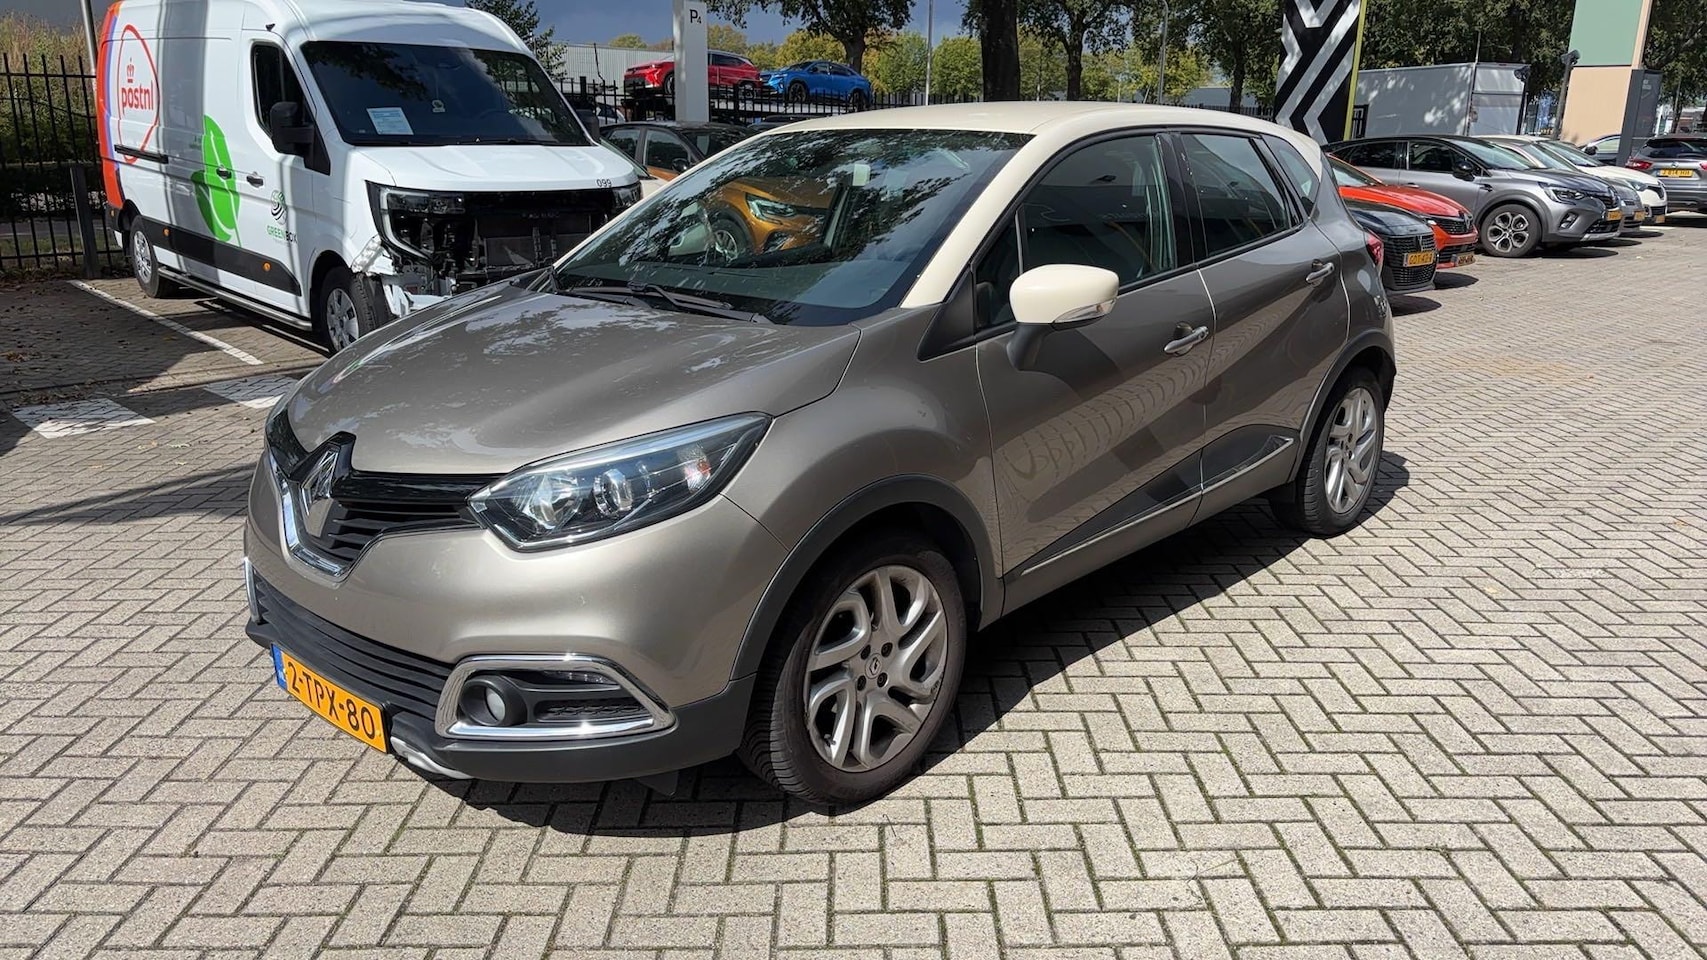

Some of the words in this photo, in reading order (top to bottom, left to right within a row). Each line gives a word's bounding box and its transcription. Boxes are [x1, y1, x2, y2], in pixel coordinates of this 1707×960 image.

[121, 80, 154, 117] postnl
[596, 178, 612, 189] 099
[287, 661, 376, 740] 2-TPX-80
